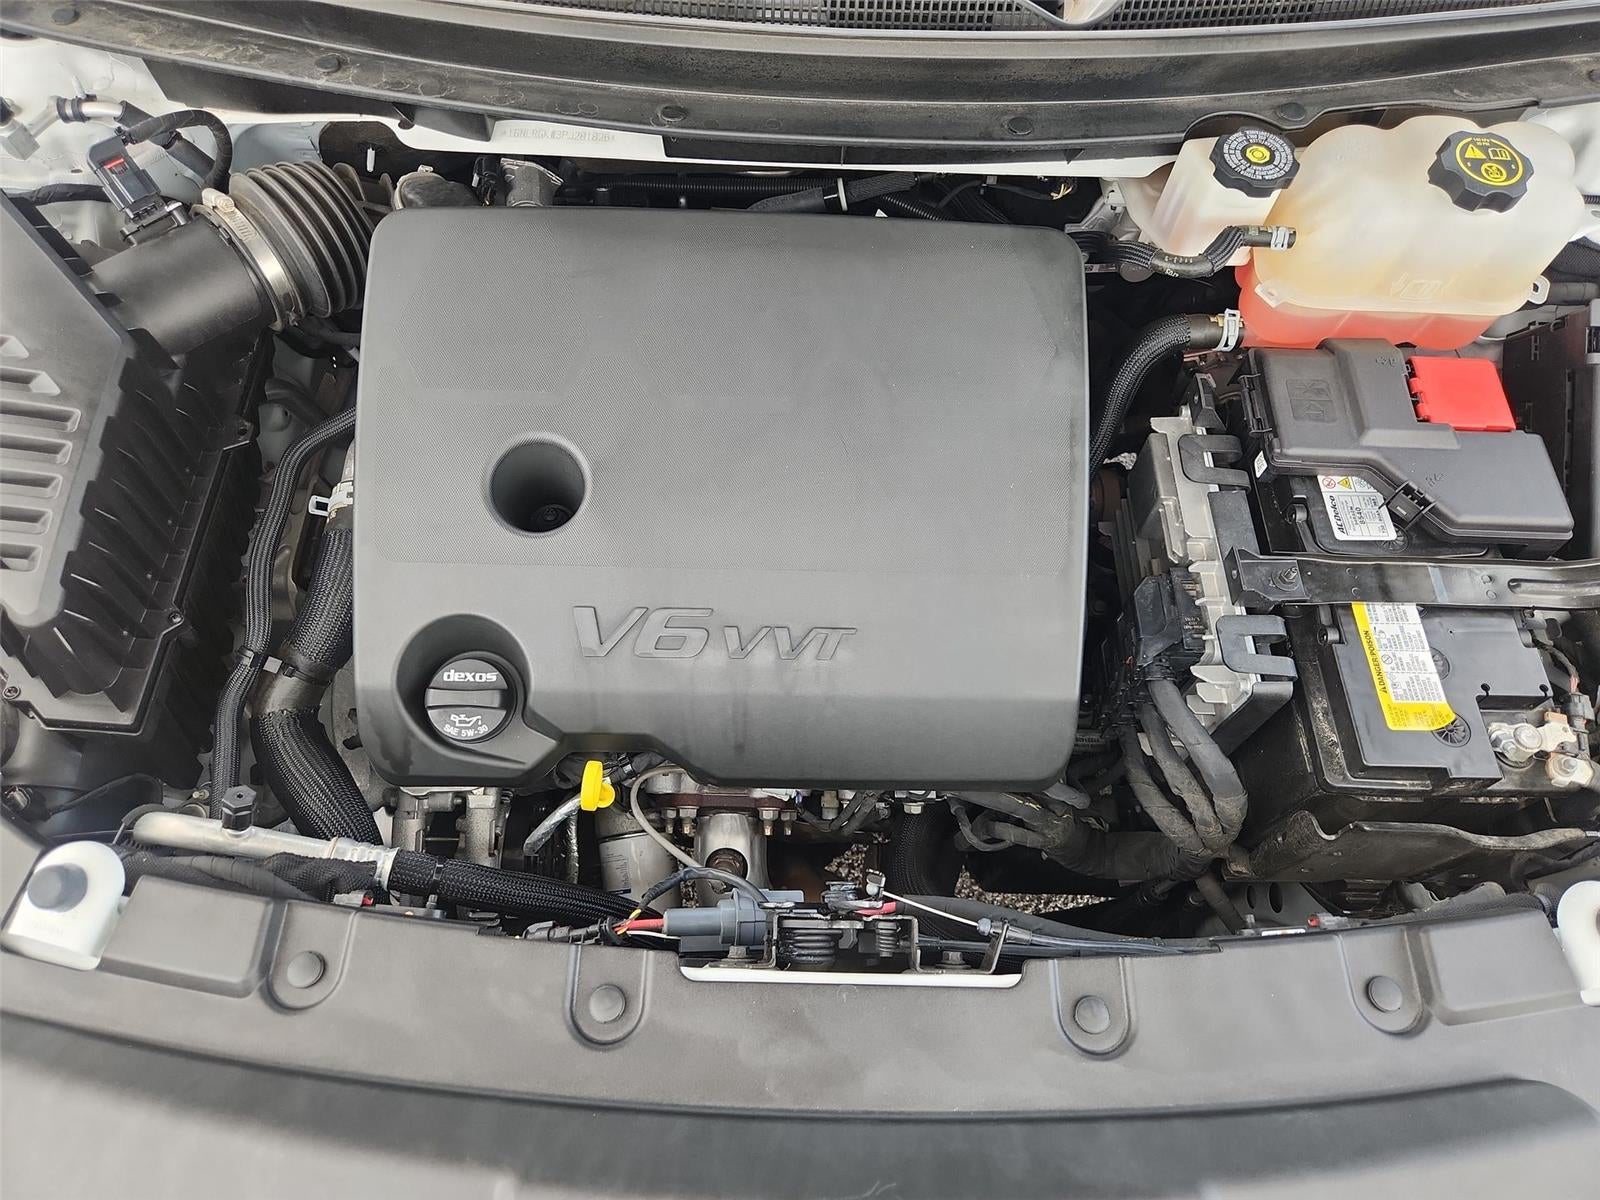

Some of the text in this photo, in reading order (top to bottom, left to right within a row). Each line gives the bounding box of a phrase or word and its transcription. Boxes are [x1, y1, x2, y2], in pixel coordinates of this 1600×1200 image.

[1329, 495, 1346, 535] ACDelco
[573, 605, 858, 661] V6 VVT
[443, 669, 499, 683] dexos
[443, 723, 489, 738] SAE 5W-30
